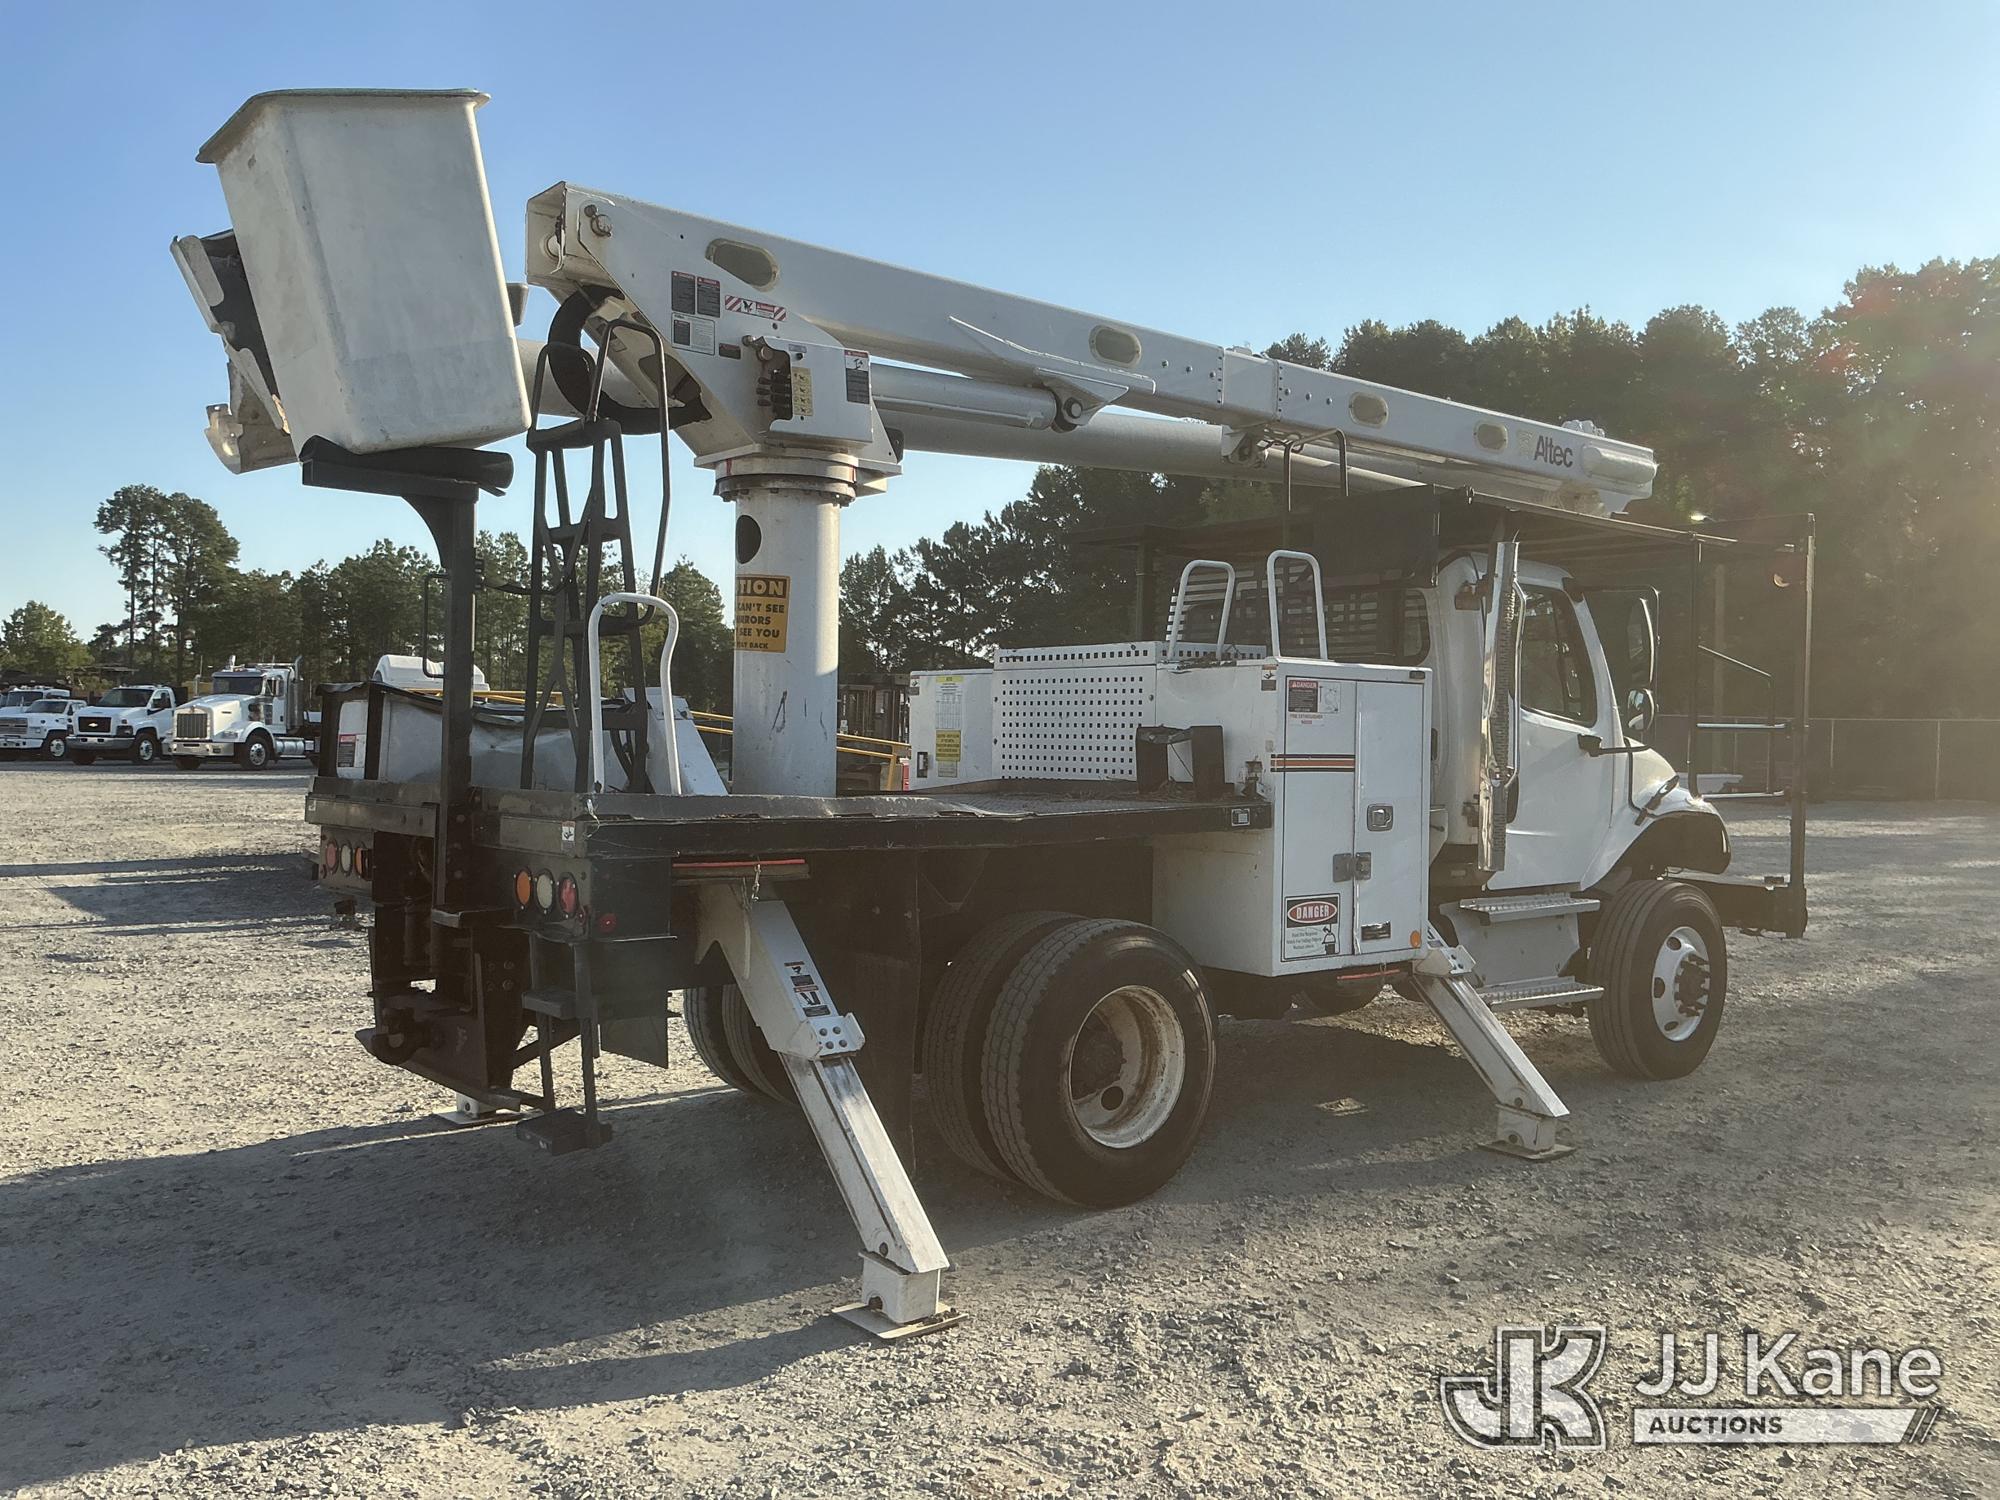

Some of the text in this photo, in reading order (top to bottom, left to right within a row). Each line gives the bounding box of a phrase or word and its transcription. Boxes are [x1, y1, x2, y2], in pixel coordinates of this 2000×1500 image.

[1534, 435, 1573, 468] Altec
[736, 579, 784, 596] TION
[765, 603, 785, 613] SEE
[756, 628, 780, 638] YOU
[1296, 904, 1330, 920] DANGER
